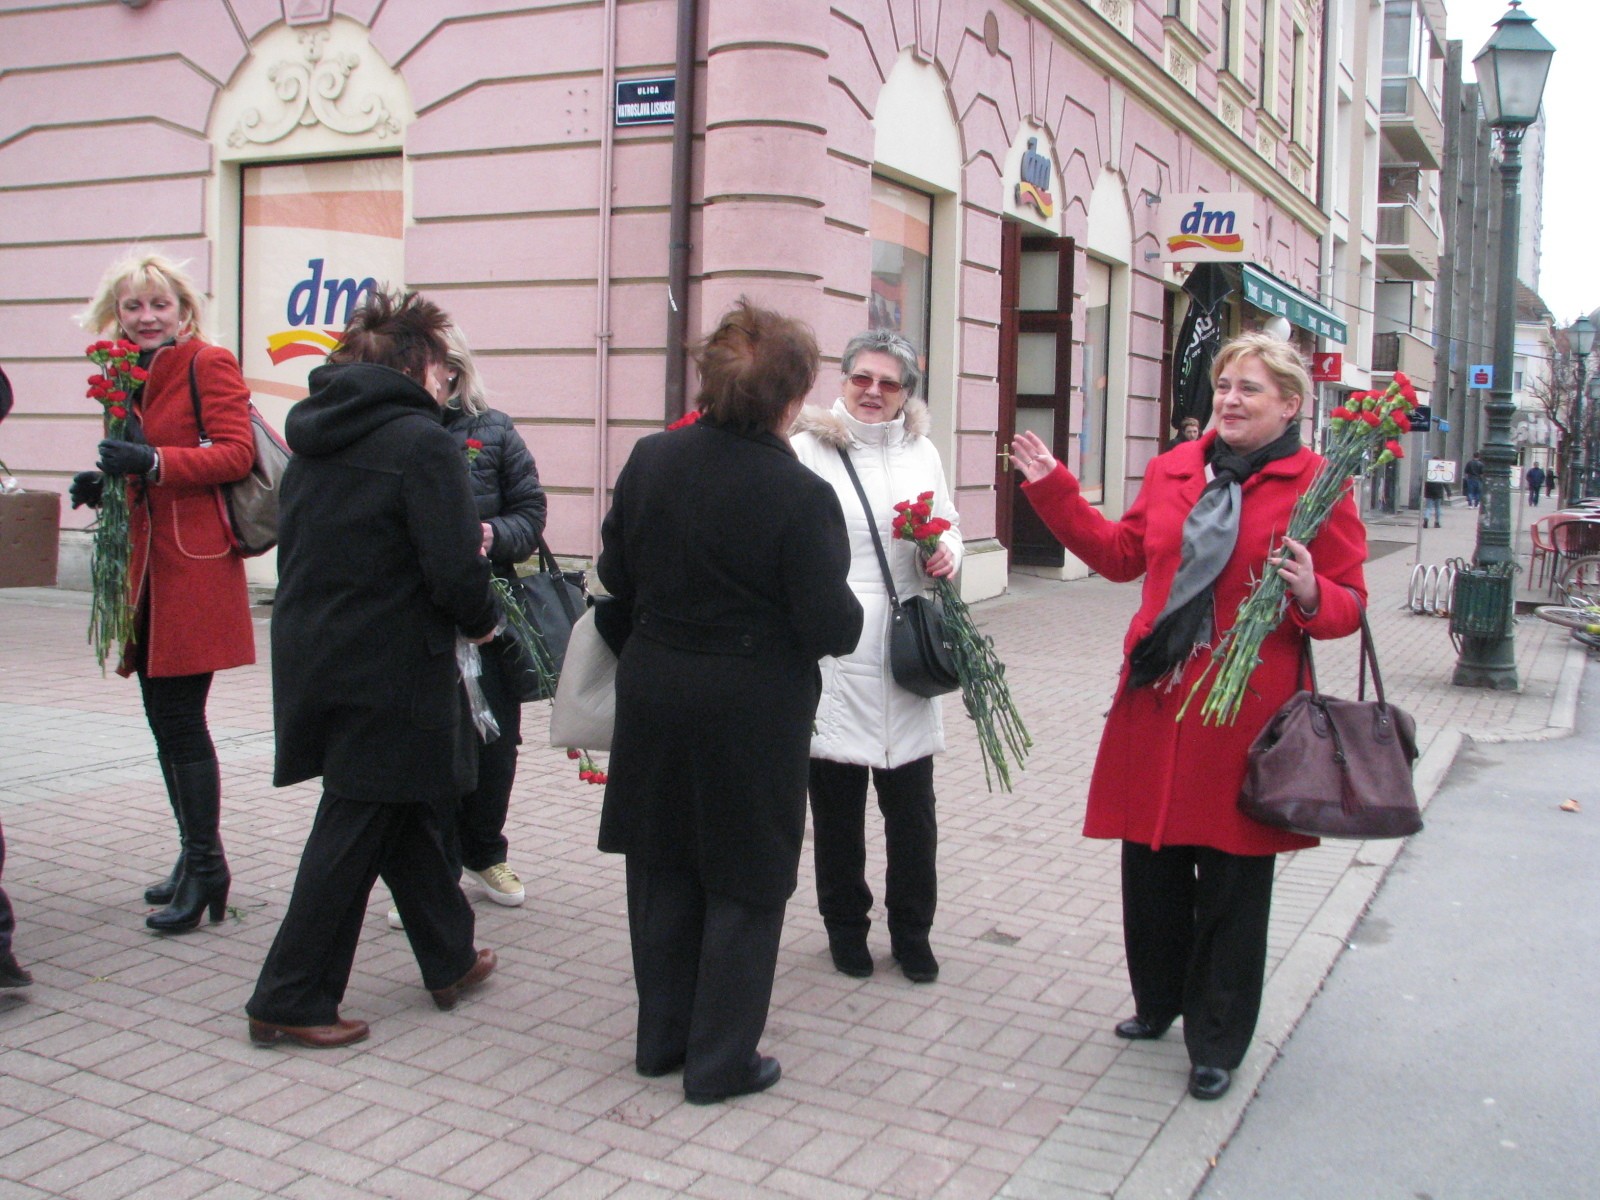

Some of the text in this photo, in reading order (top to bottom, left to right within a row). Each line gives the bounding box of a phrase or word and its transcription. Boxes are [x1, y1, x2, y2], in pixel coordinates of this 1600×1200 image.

[637, 86, 659, 95] ULICA
[617, 102, 650, 118] VATROSLAVA
[1021, 137, 1051, 190] dm
[1180, 201, 1236, 235] dm
[287, 257, 378, 327] dm
